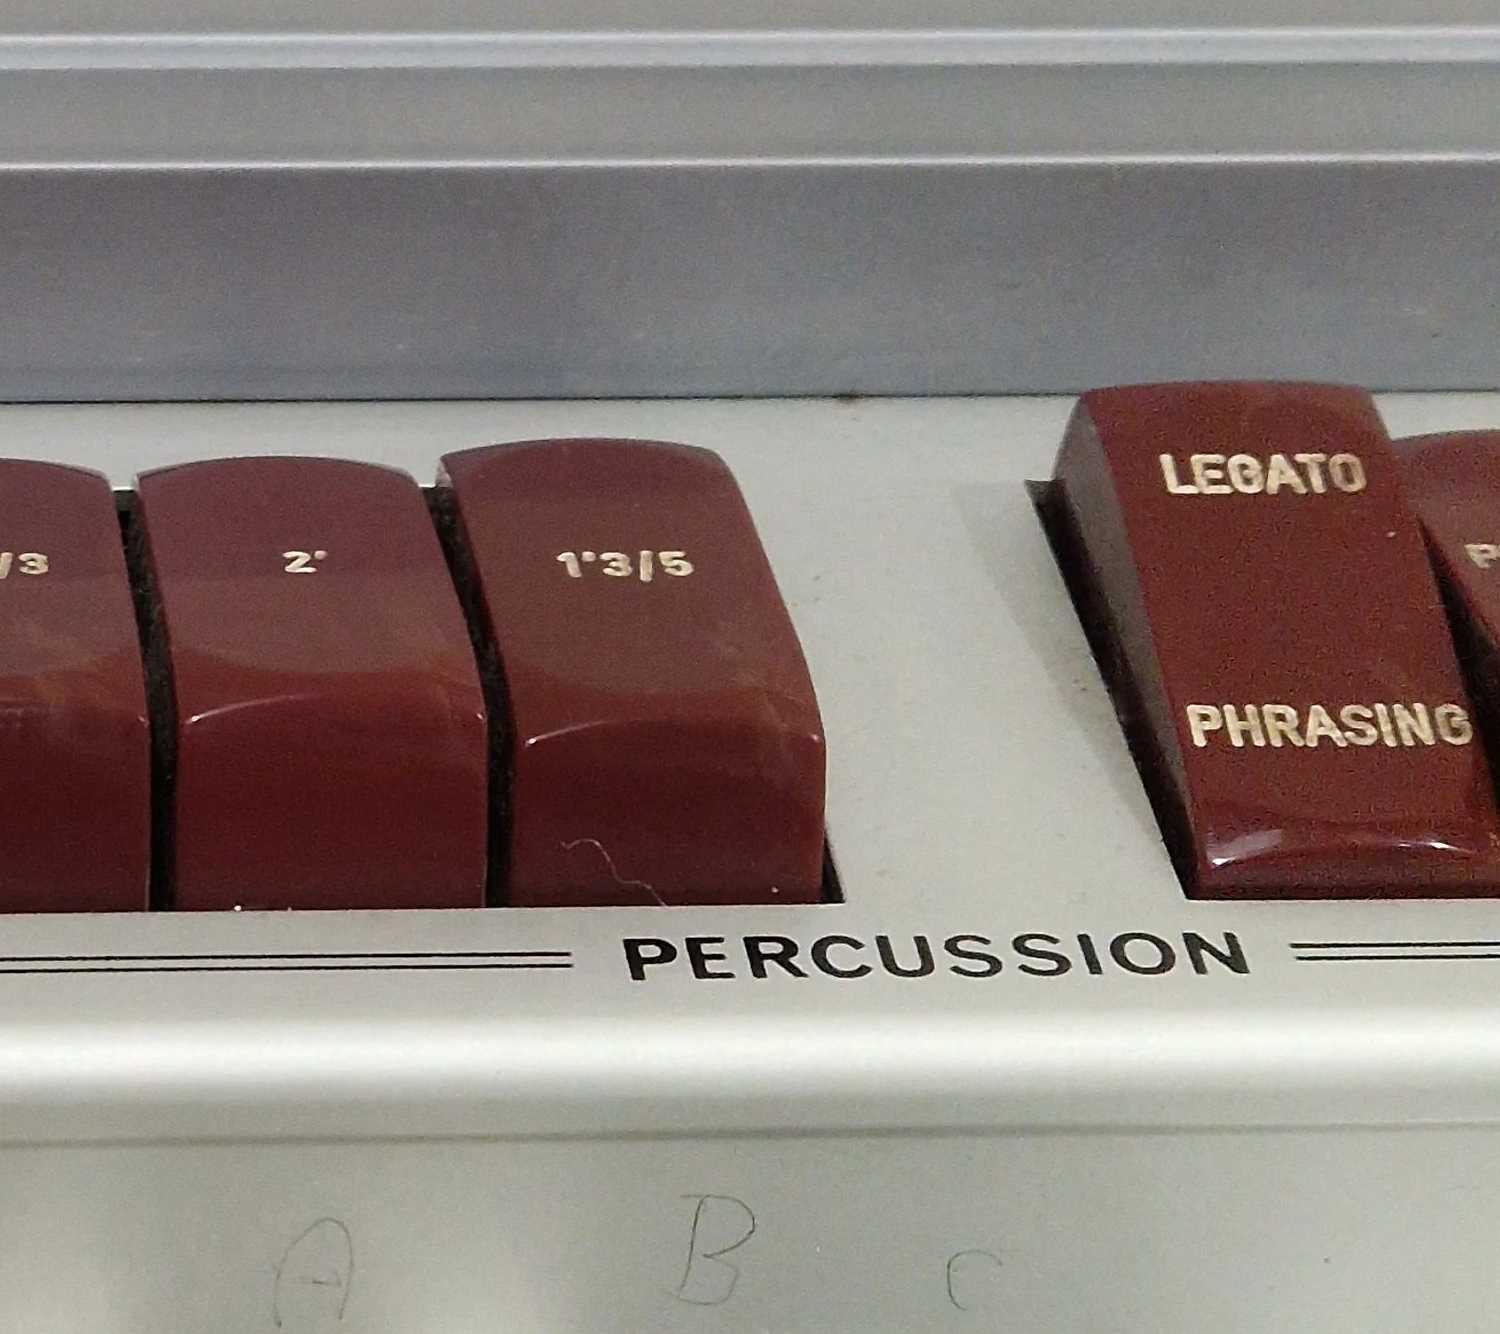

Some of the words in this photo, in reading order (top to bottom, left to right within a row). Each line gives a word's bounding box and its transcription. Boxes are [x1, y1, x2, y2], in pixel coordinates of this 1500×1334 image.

[1158, 453, 1368, 495] LEGATO
[1185, 703, 1474, 748] PHRASING
[622, 932, 1252, 981] PERCUSSION
[667, 1193, 757, 1307] B
